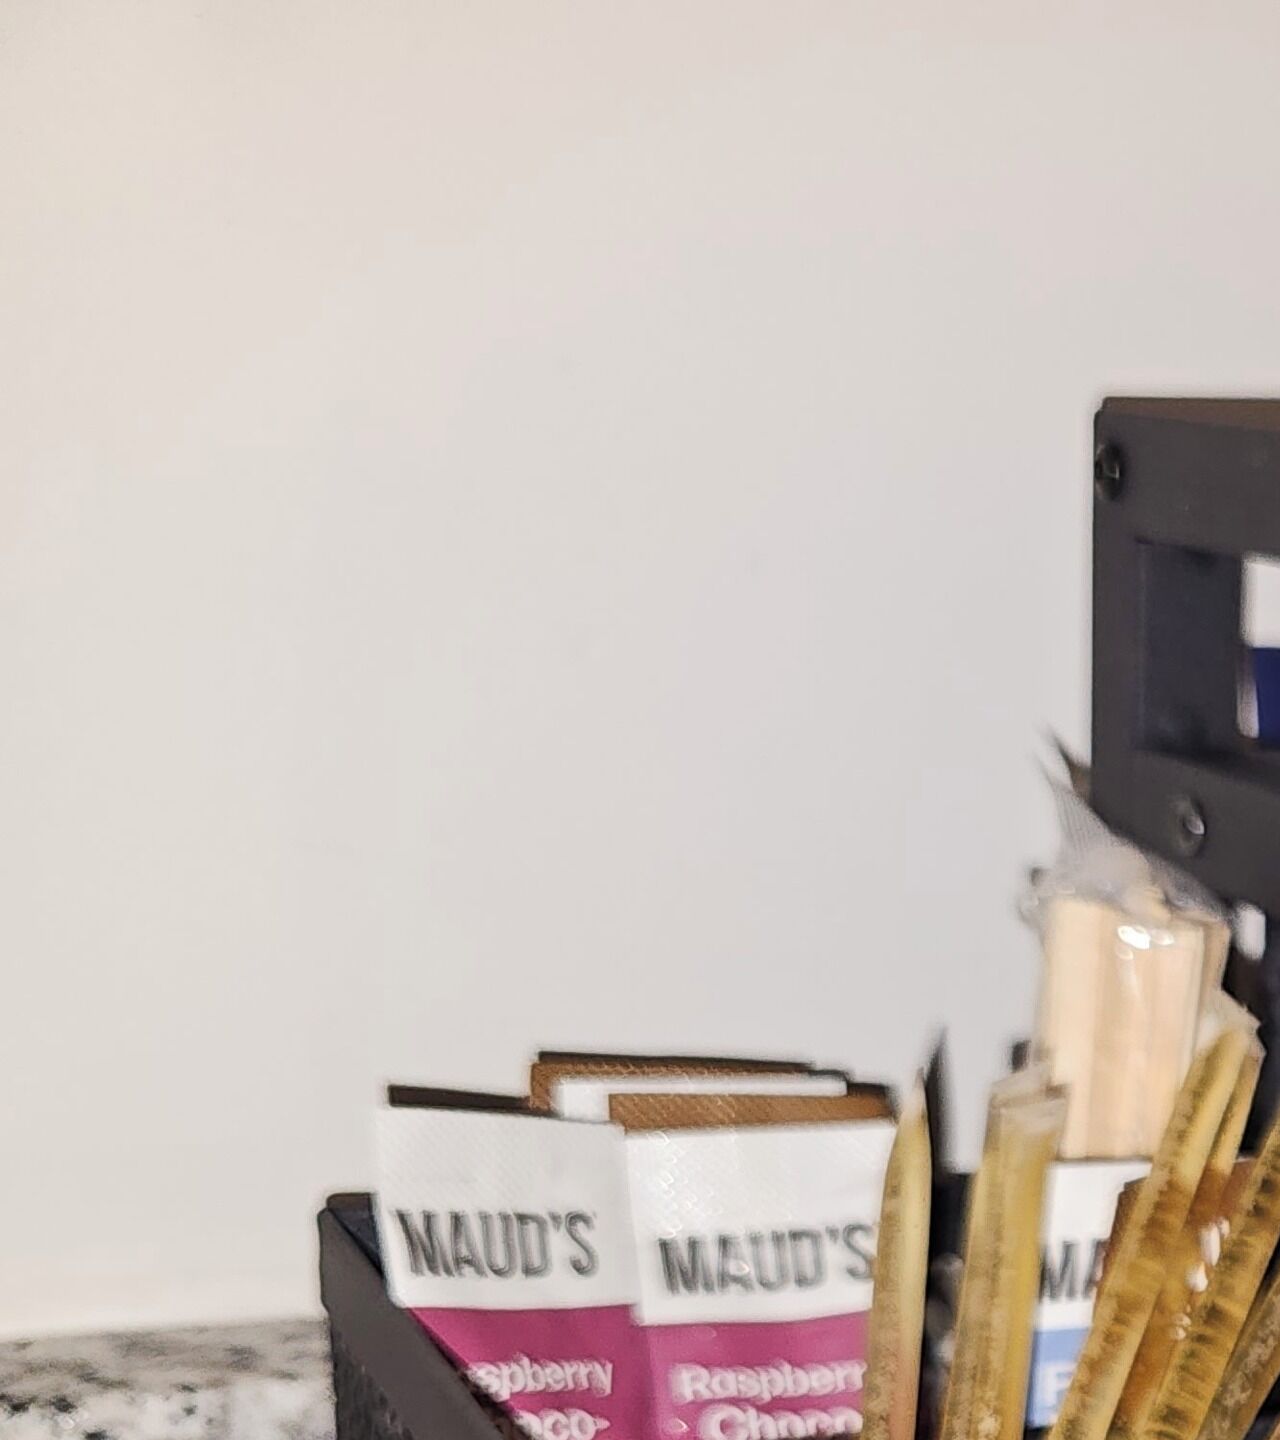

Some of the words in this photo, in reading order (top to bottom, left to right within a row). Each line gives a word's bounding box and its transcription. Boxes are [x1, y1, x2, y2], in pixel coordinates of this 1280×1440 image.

[393, 1210, 598, 1277] MAUD'S
[658, 1224, 873, 1294] MAUD'S
[466, 1352, 613, 1402] spberry
[673, 1358, 867, 1404] Raspberr
